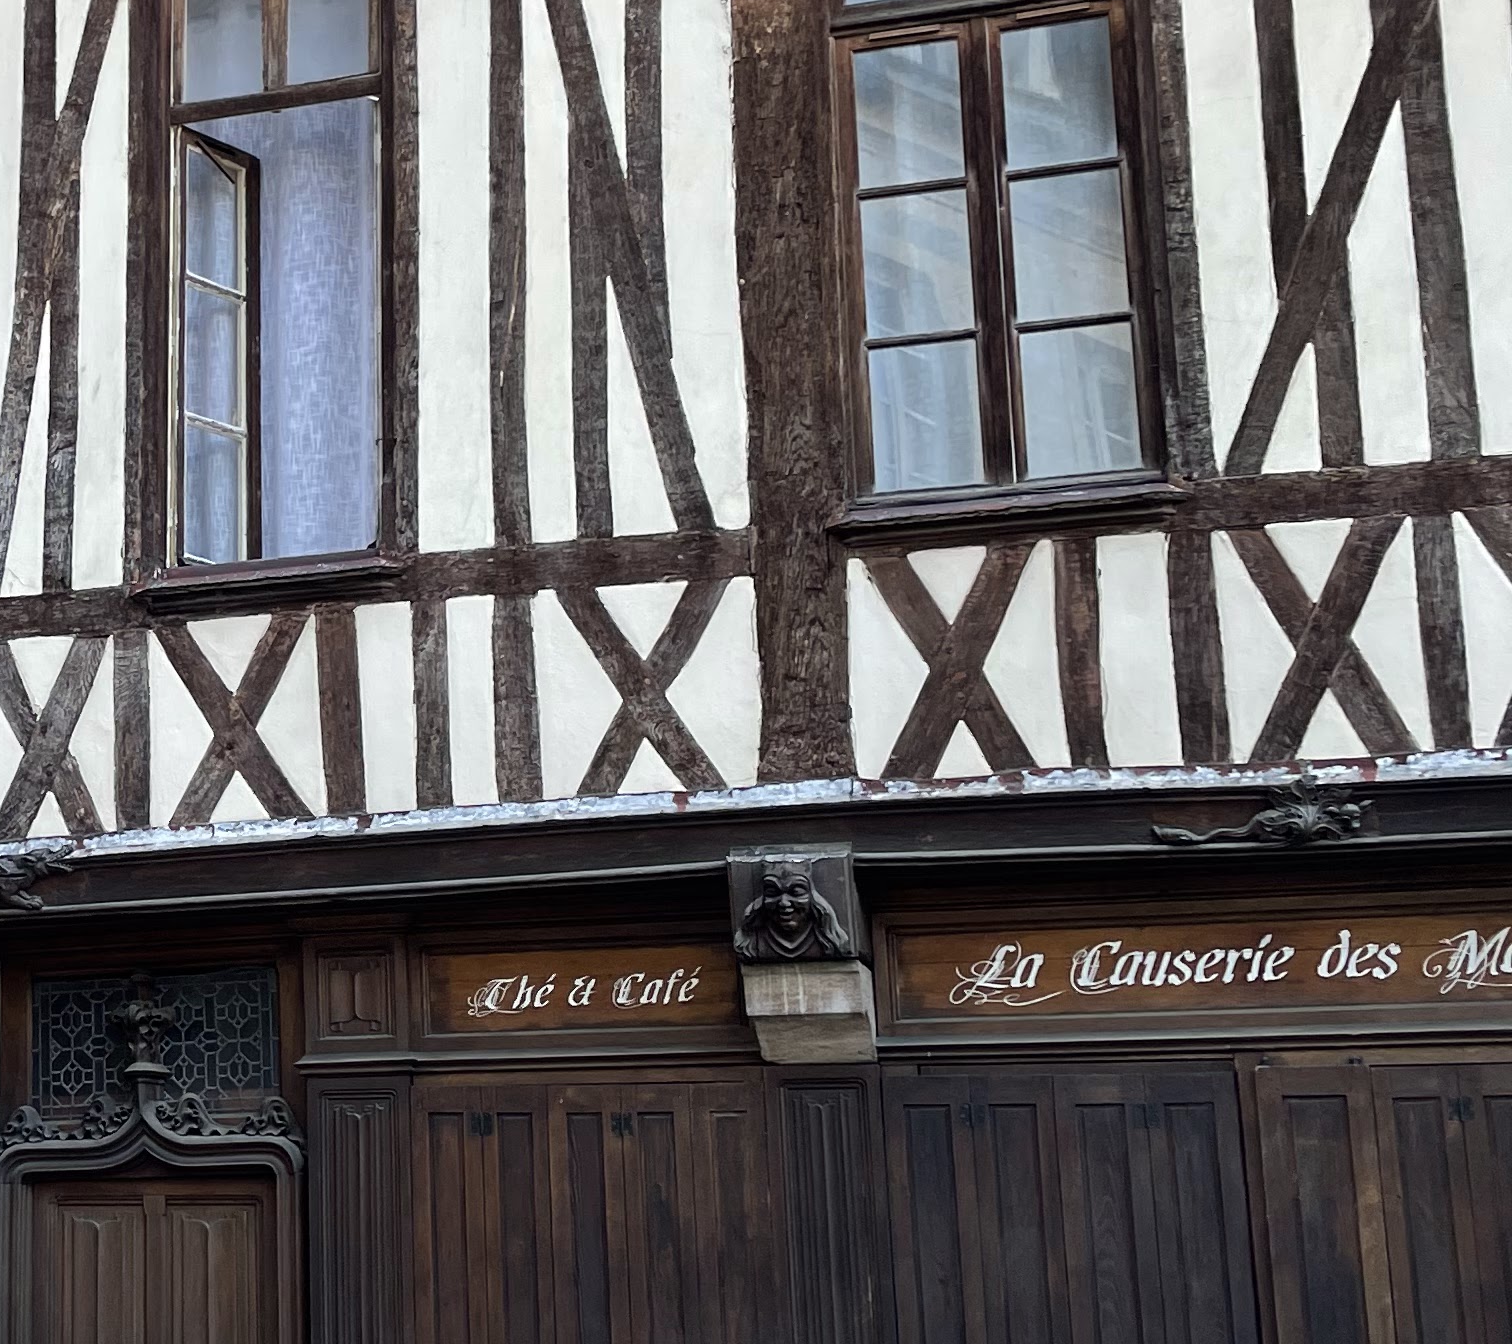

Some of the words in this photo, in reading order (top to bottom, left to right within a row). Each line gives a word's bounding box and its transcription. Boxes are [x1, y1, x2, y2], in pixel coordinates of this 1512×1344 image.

[468, 972, 557, 1017] Thé
[567, 975, 597, 1007] &
[612, 965, 703, 1010] Café
[952, 941, 1046, 1006] La
[1069, 933, 1296, 994] Causerie
[1316, 929, 1402, 980] des
